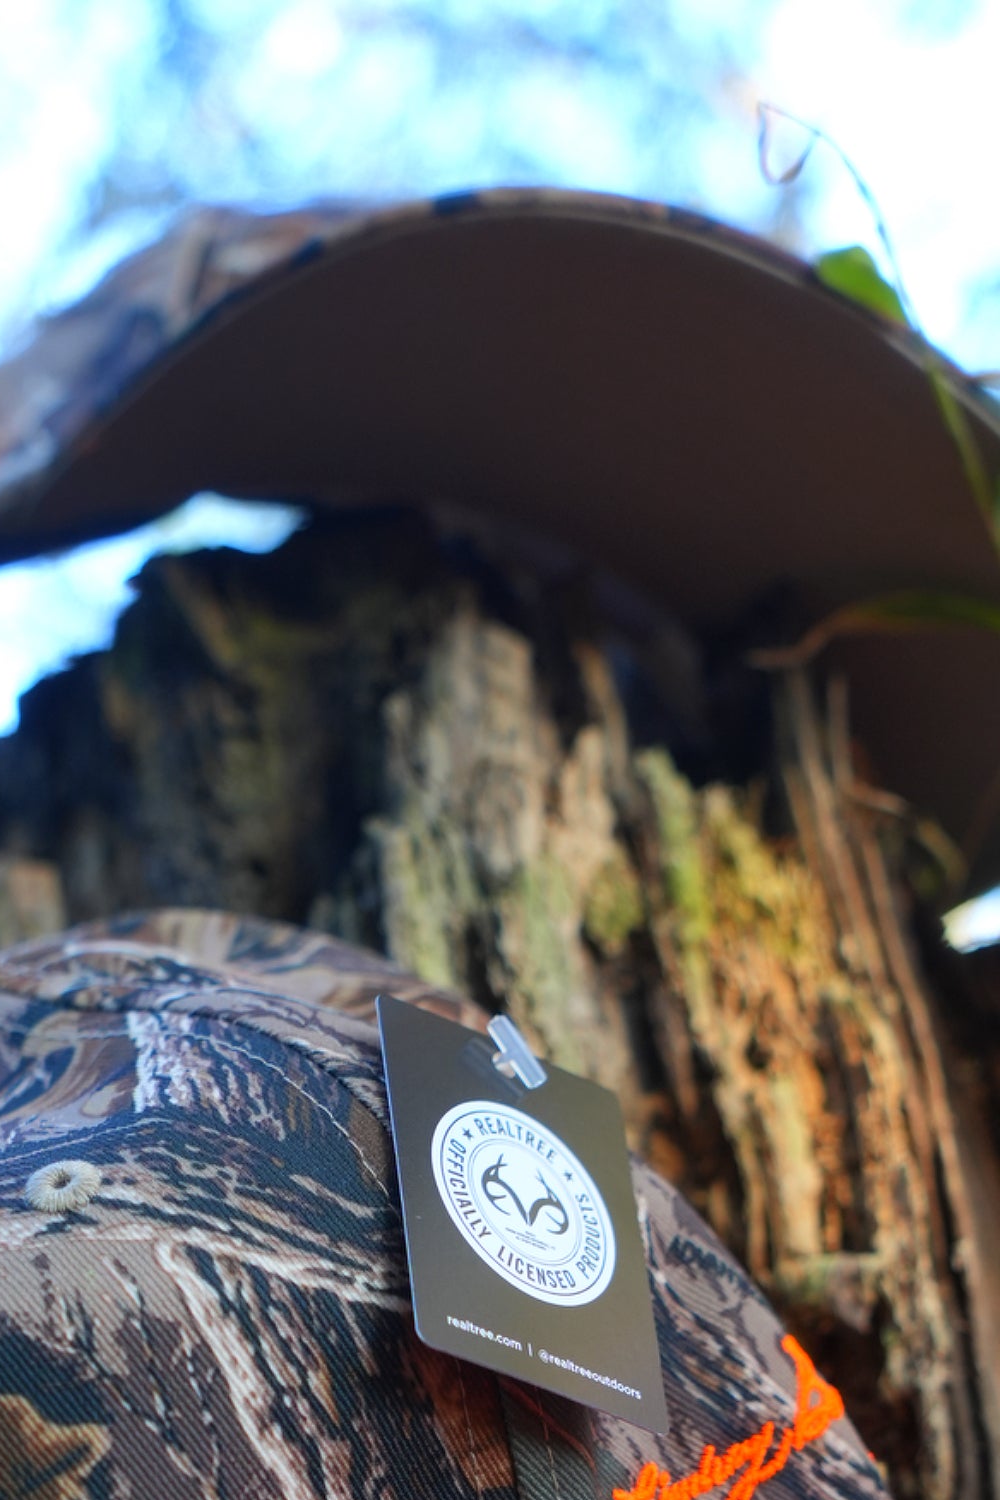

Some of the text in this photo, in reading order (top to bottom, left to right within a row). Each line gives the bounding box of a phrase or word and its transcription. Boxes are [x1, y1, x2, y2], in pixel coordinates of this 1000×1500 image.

[474, 1117, 555, 1163] REALTREE
[447, 1138, 602, 1290] OFFICIALLY LICENSED PRODUCTS
[446, 1315, 523, 1352] realtree.com
[537, 1349, 642, 1400] @realtreeoutdoors
